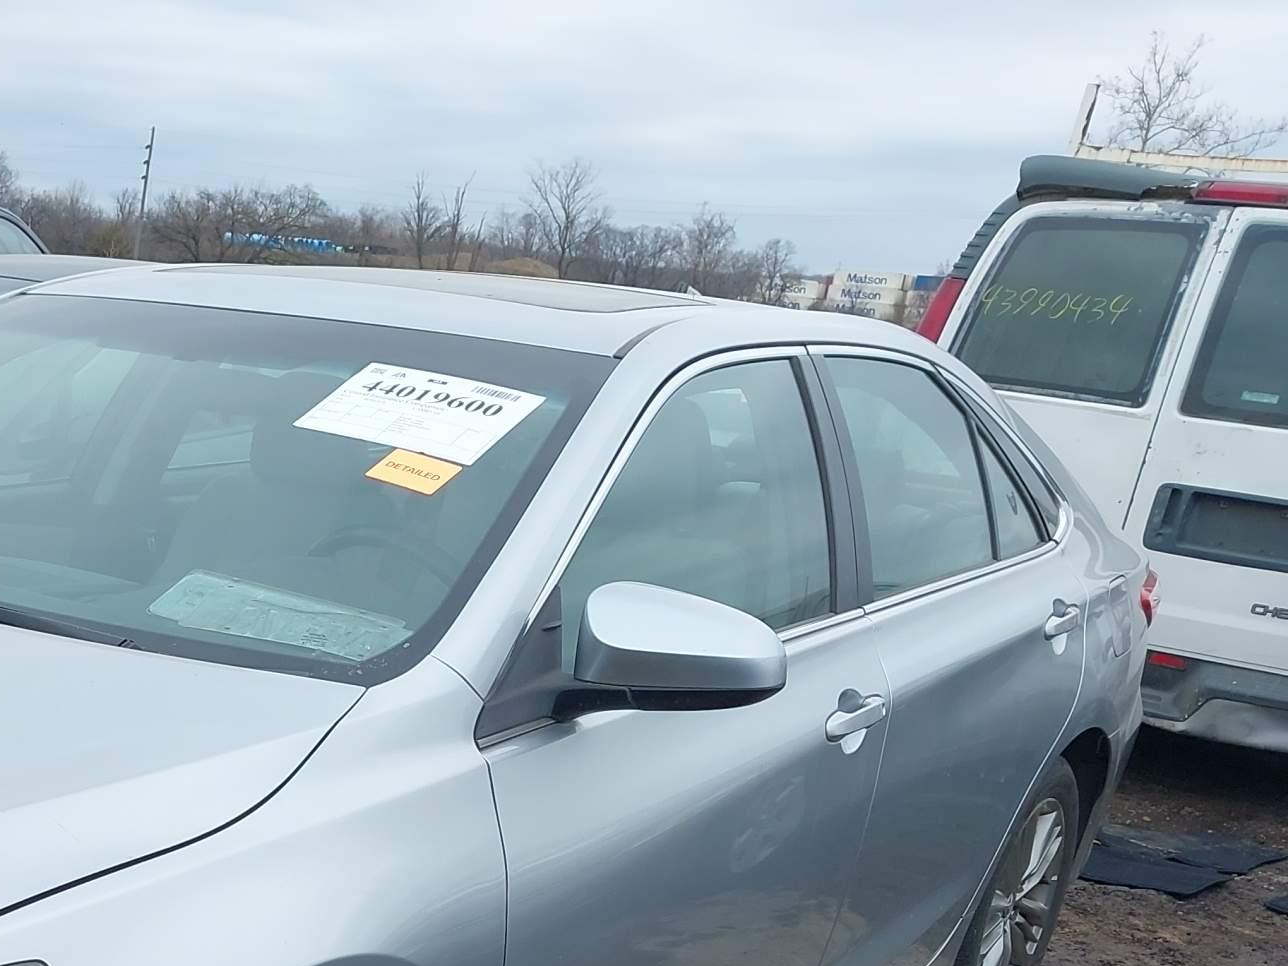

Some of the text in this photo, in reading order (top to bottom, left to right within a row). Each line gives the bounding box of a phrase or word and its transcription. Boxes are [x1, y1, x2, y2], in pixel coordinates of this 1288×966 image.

[846, 273, 888, 286] Matson
[361, 380, 505, 418] 44019600
[384, 460, 441, 482] DETAILED
